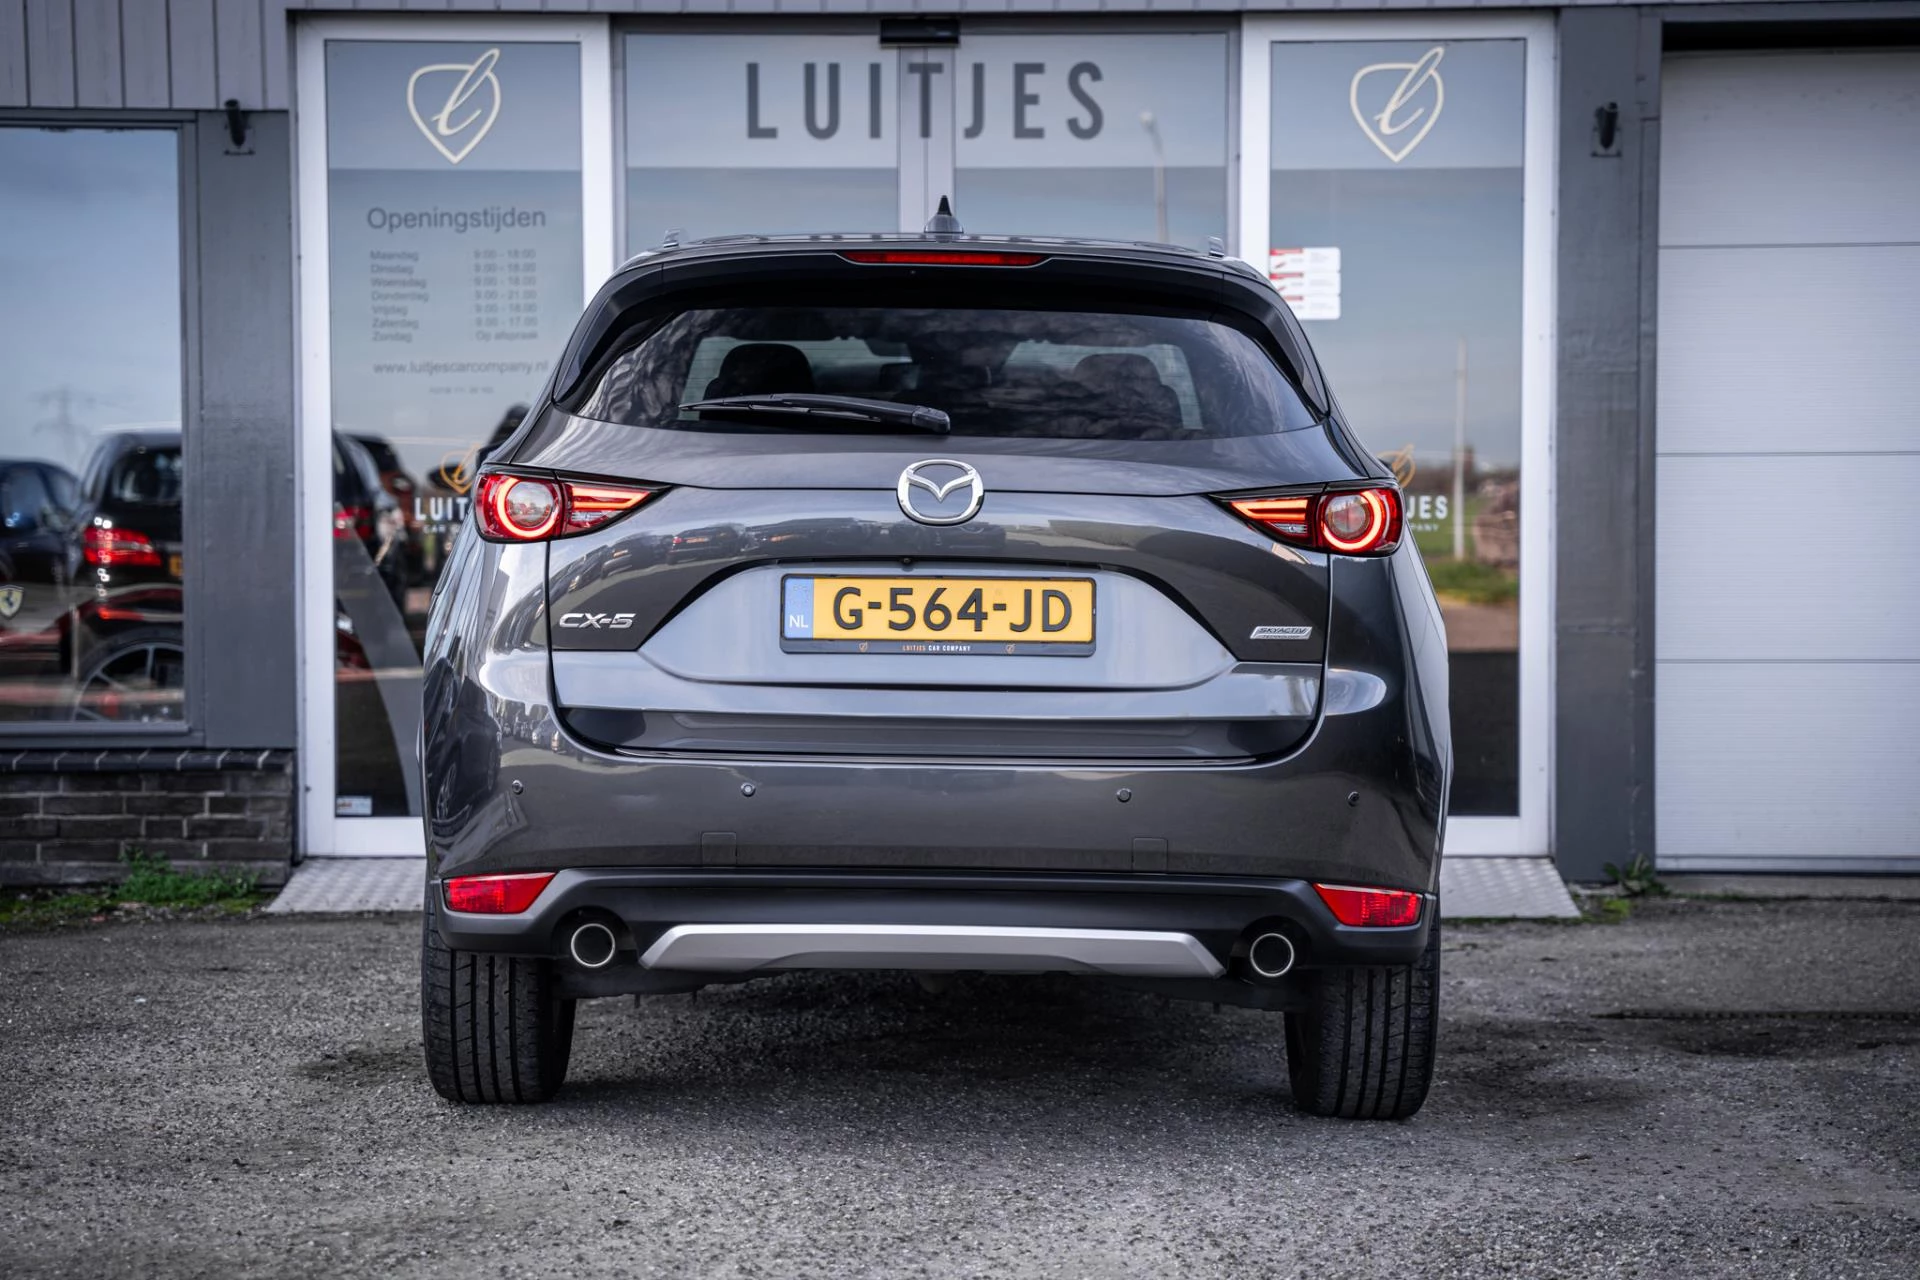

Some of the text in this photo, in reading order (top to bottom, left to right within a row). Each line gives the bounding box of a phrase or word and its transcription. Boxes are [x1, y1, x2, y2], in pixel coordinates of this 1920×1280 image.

[746, 61, 1104, 140] LUITJES
[367, 206, 546, 234] Openingstijden
[373, 360, 549, 376] www.luitjescarcompany.nl
[415, 497, 469, 521] LUIT
[1406, 495, 1448, 520] JES
[559, 612, 636, 629] CX-5
[789, 615, 808, 628] NL
[833, 586, 1072, 633] G-564-JD
